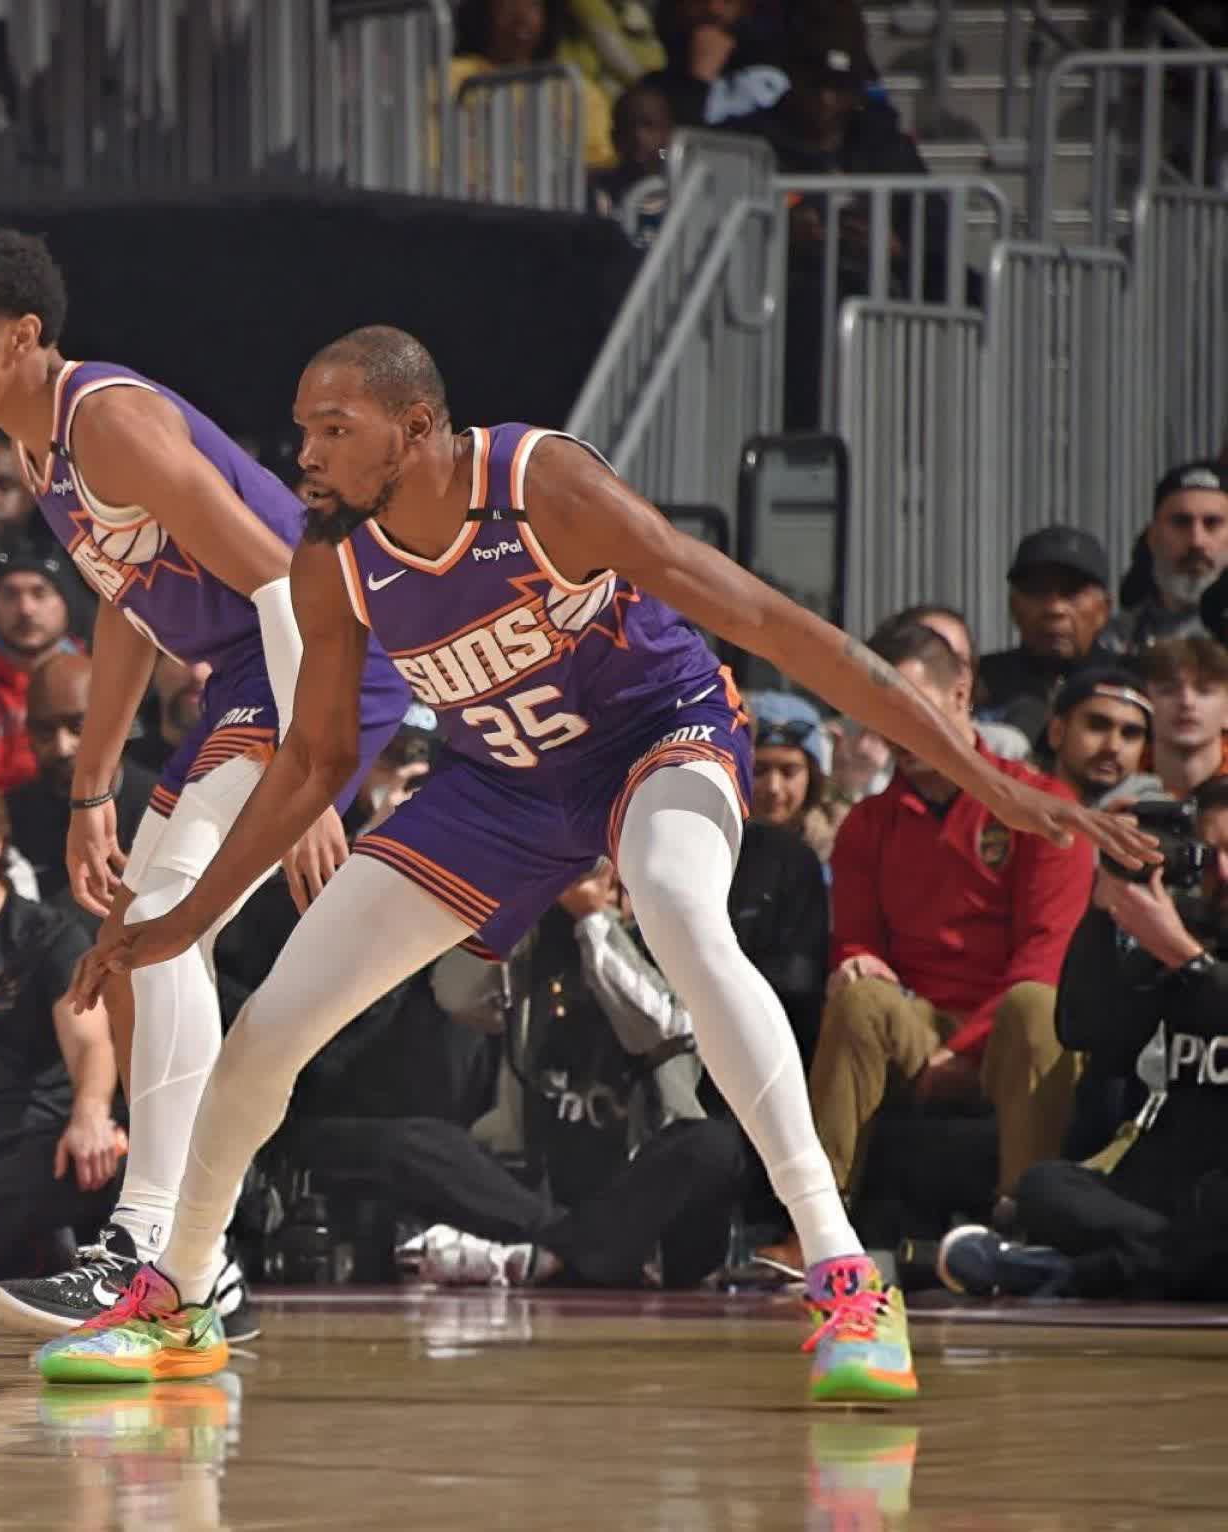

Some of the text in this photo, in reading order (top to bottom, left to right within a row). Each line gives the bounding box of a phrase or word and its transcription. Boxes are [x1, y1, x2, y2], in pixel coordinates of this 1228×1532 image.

[472, 539, 523, 561] PayPal
[393, 606, 552, 705] SUNS
[461, 684, 590, 768] 35
